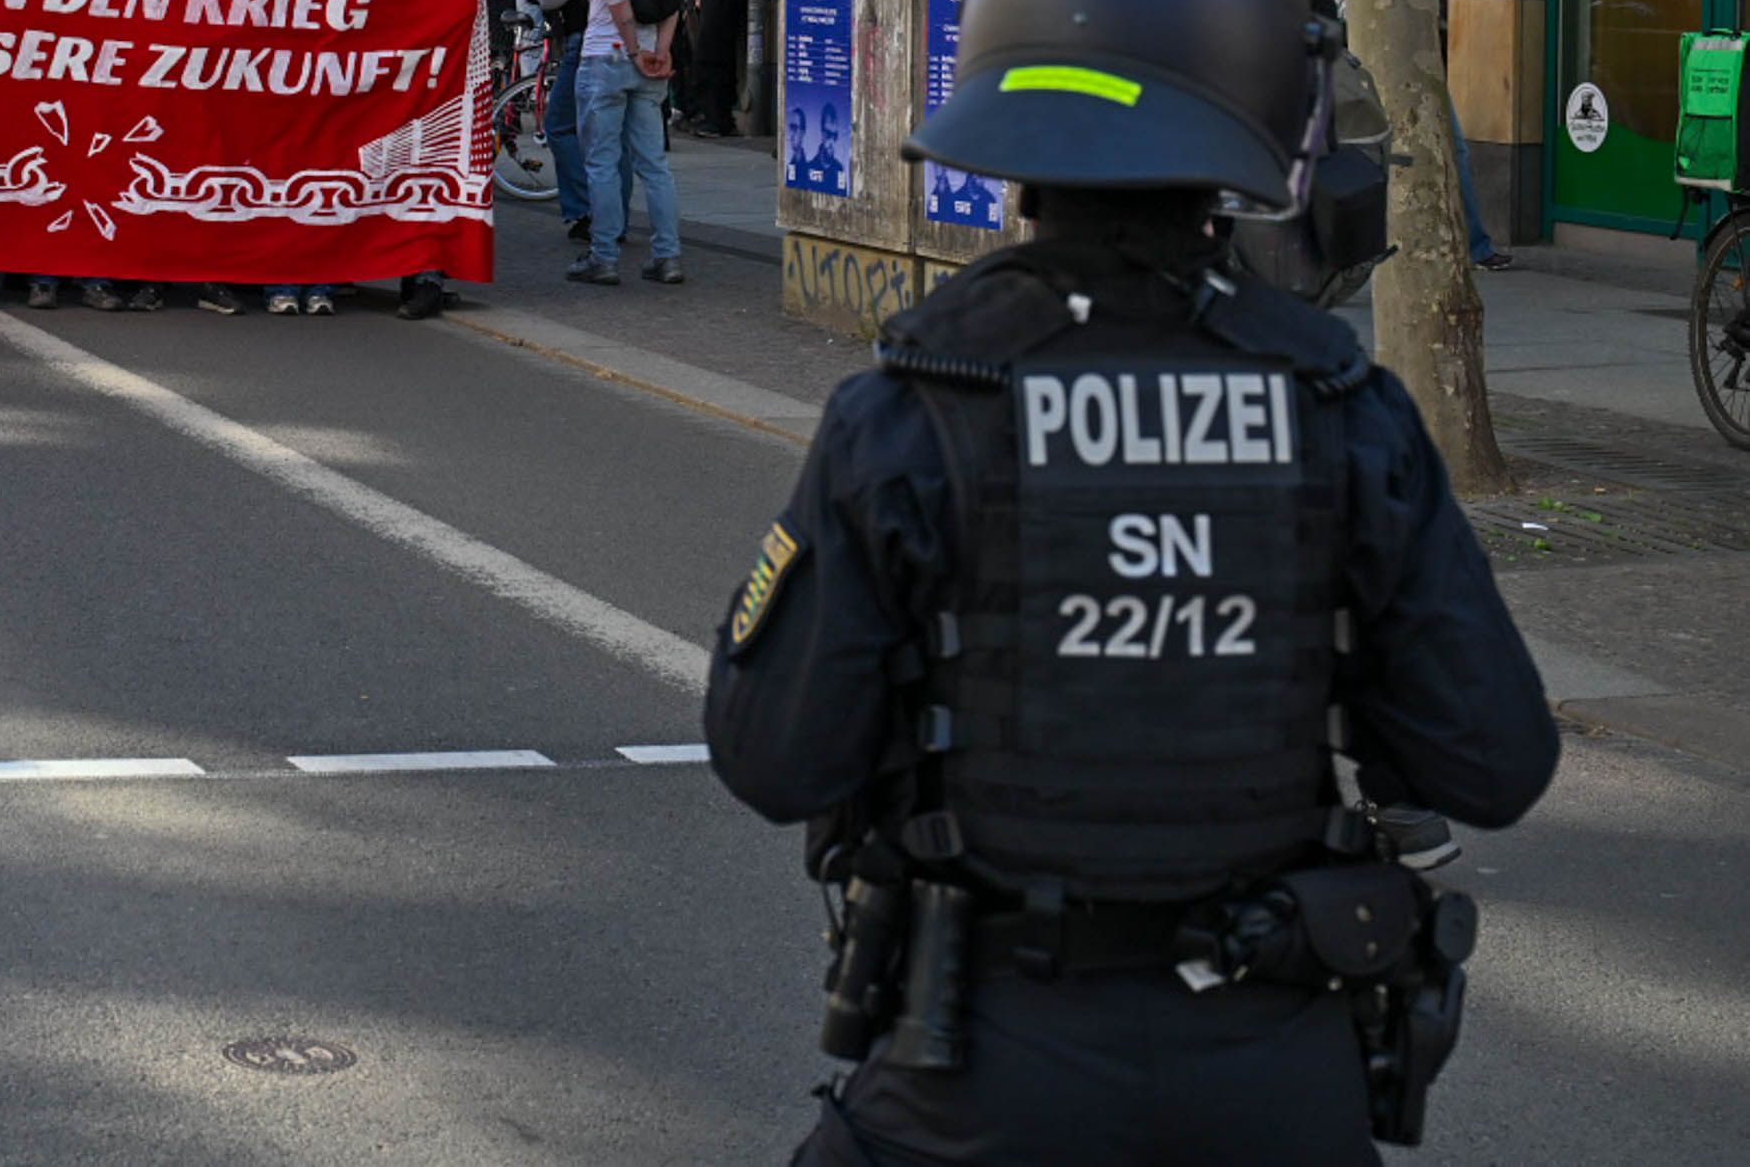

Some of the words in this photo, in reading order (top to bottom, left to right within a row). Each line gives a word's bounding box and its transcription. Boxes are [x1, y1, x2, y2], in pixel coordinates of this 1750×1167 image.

[138, 46, 447, 96] ZUKUNFT!
[1023, 373, 1294, 466] POLIZEI
[1108, 514, 1213, 578] SN
[1058, 595, 1257, 659] 22/12
